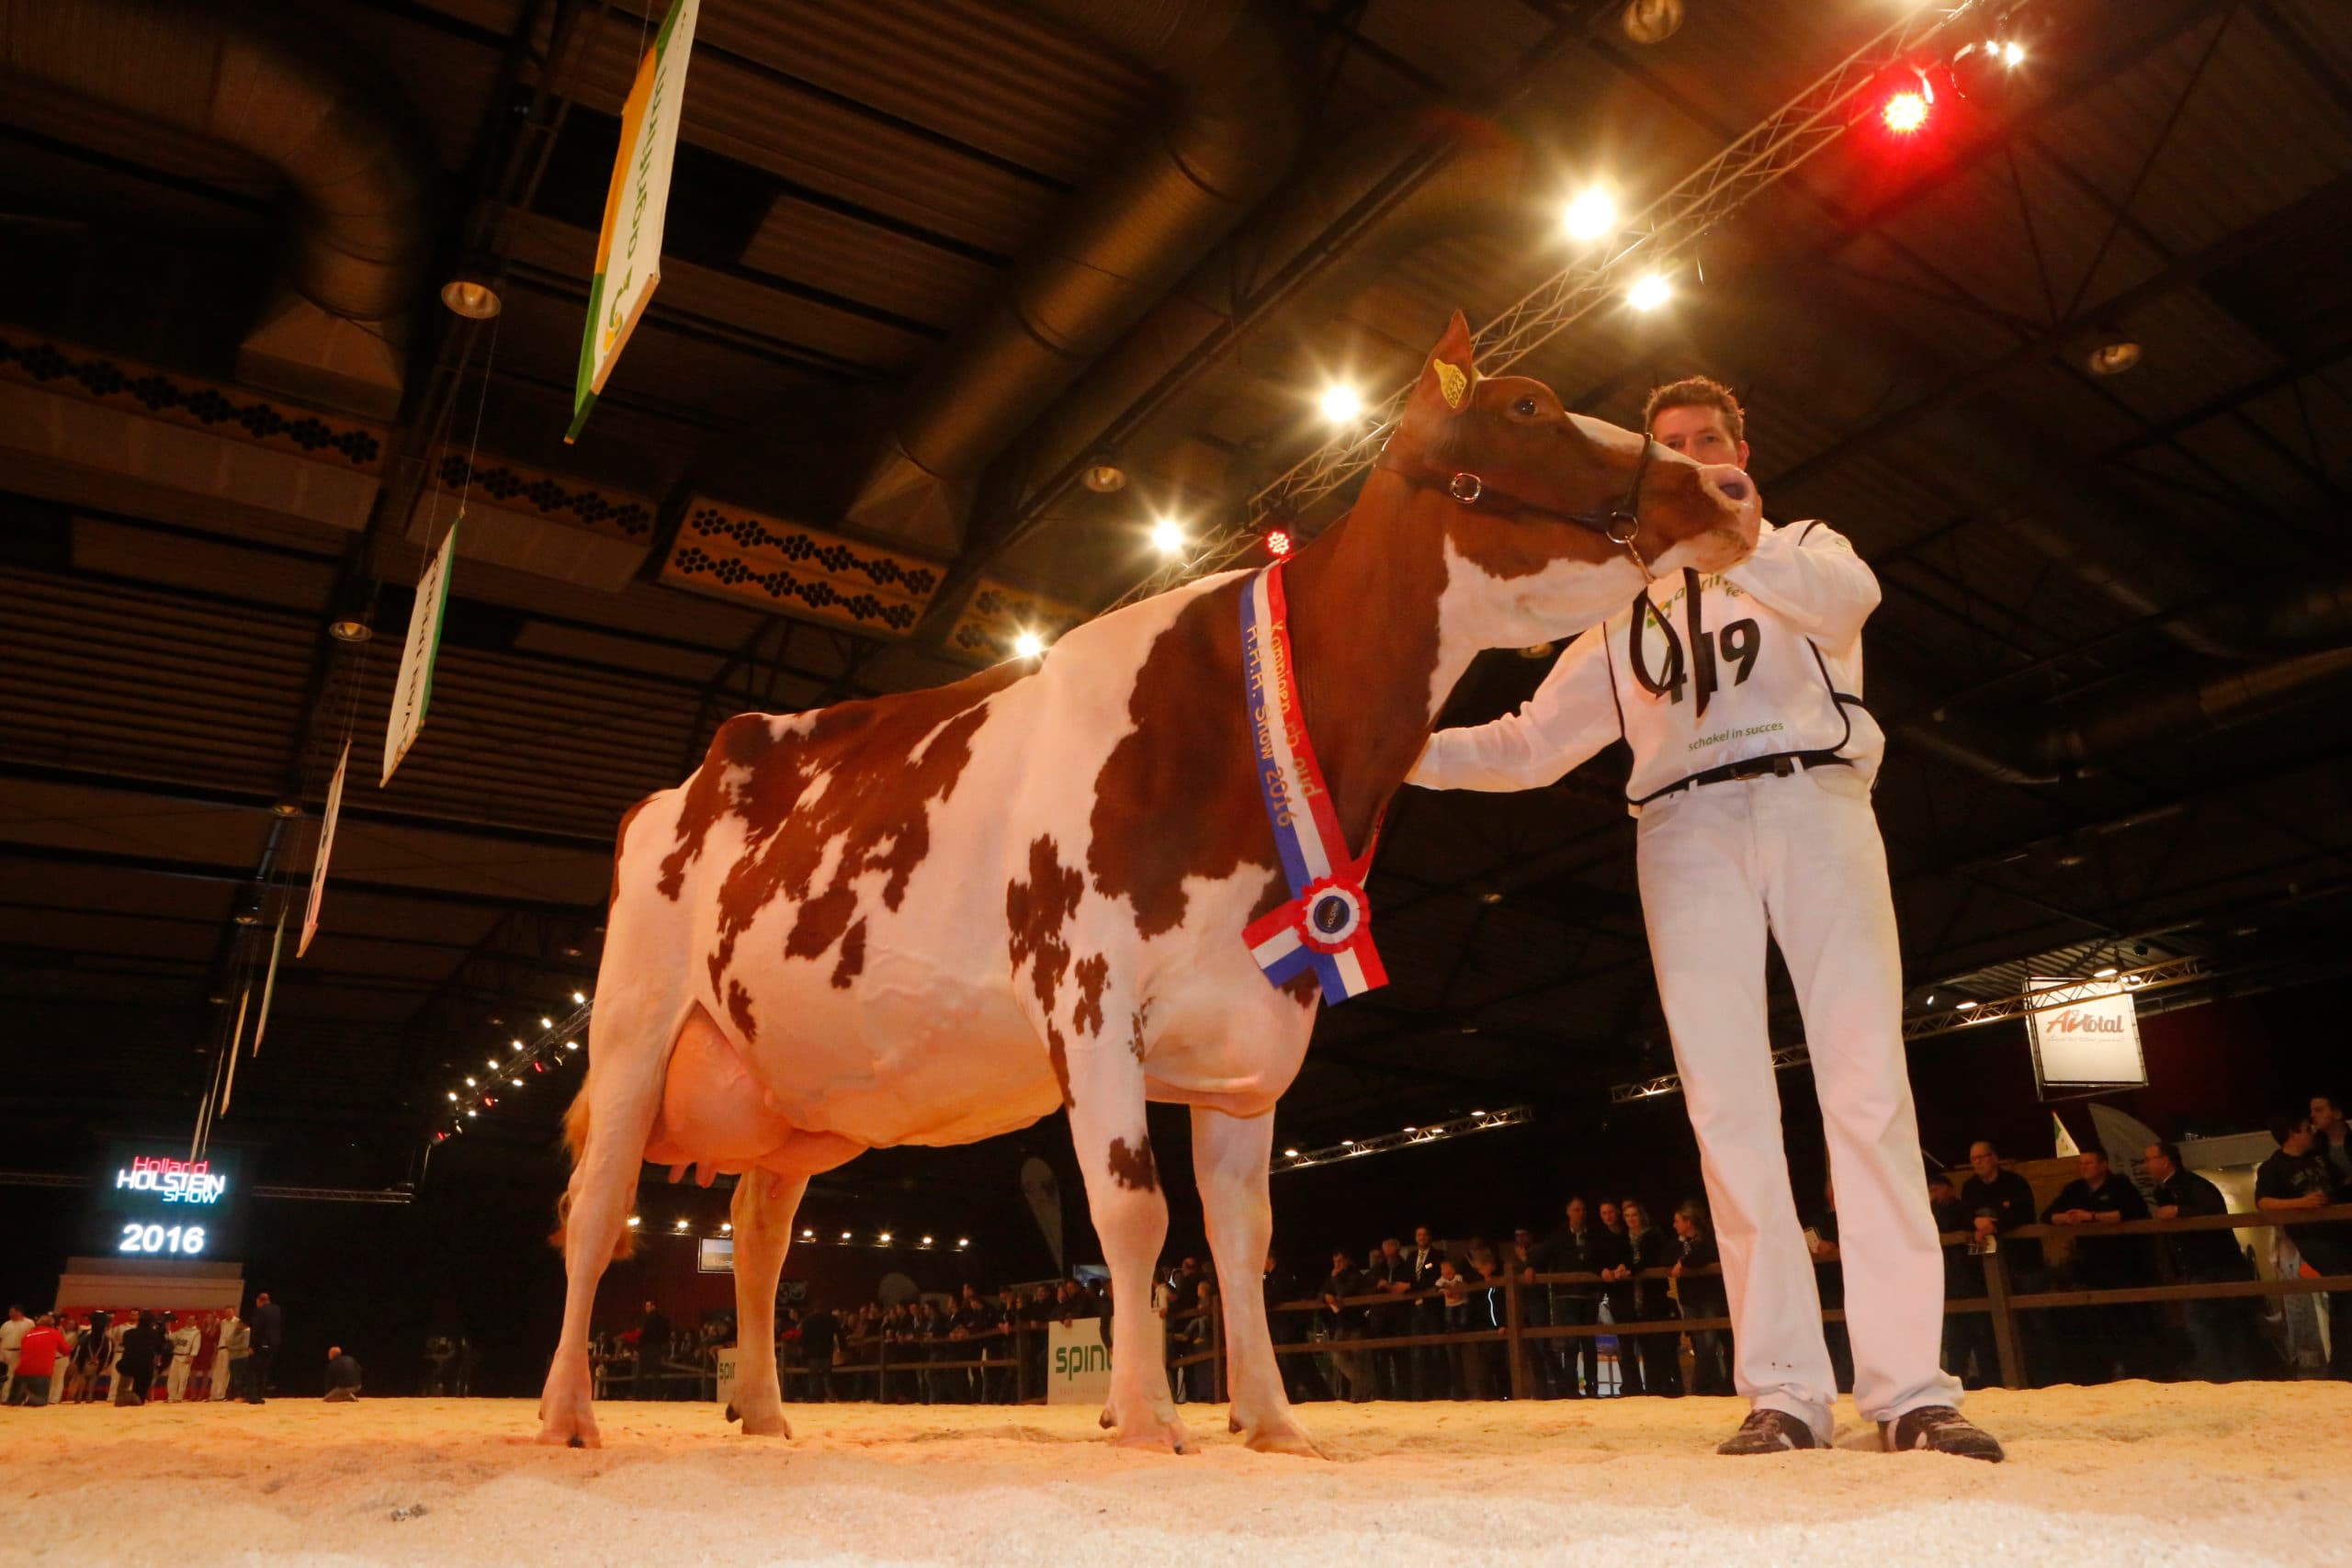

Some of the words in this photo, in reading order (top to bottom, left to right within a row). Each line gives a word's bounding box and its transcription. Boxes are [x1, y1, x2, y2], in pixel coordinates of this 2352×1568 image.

[1247, 625, 1265, 698] H.H.H.
[1255, 704, 1275, 761] Show
[1689, 728, 1729, 751] schakel
[1732, 728, 1742, 739] in
[1746, 722, 1784, 737] succes
[1265, 765, 1298, 828] 2016
[117, 1168, 226, 1194] HOLSTEIN
[162, 1189, 220, 1205] SHOW
[119, 1223, 205, 1255] 2016
